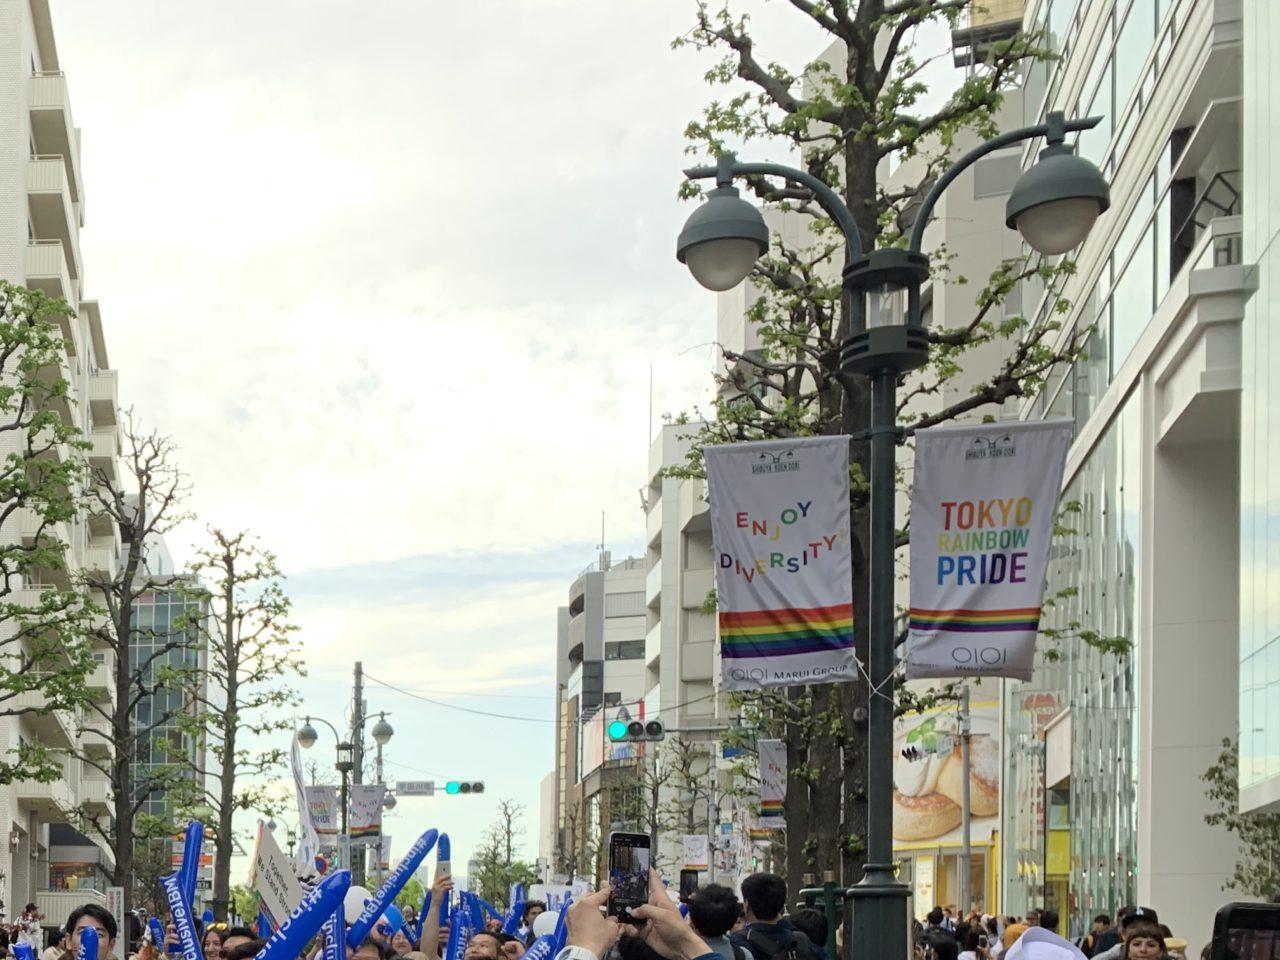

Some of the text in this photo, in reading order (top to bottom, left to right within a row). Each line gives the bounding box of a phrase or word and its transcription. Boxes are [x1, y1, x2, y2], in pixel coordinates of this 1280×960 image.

[736, 501, 812, 541] ENJOY
[941, 496, 1034, 531] TOKYO
[720, 528, 846, 583] DIVERSITY!
[937, 528, 1031, 552] RAINBOW
[937, 552, 1029, 586] PRIDE
[359, 838, 428, 924] #inclusiveIBM
